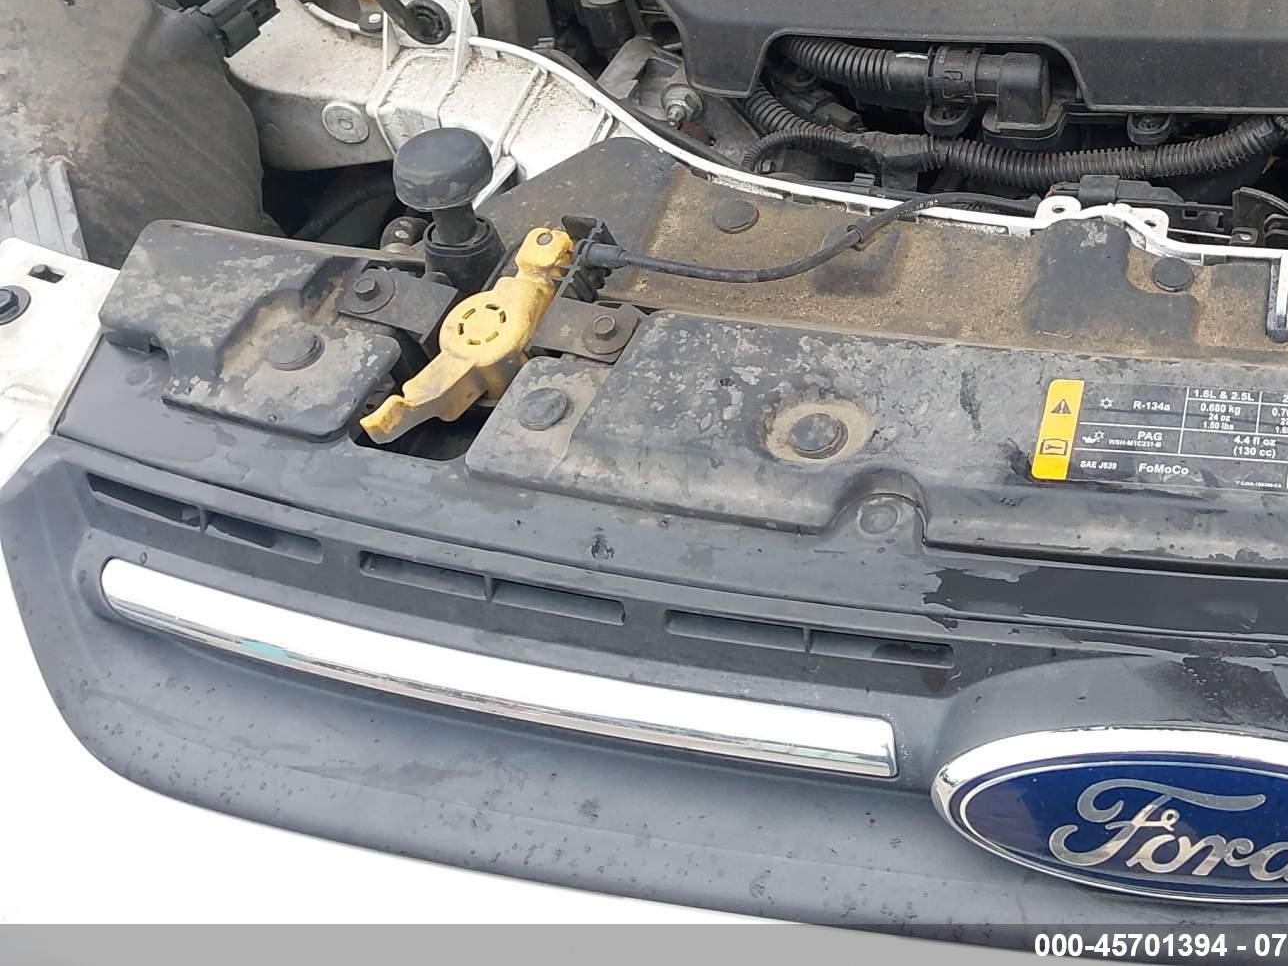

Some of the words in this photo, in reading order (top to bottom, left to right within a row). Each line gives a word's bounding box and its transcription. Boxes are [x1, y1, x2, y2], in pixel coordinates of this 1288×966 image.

[1219, 391, 1229, 400] &
[1132, 400, 1171, 411] R-134a
[1229, 404, 1241, 416] kg
[1208, 413, 1219, 421] 24
[1221, 414, 1231, 422] oz
[1221, 422, 1234, 431] lbs
[1137, 430, 1163, 441] PAG
[1233, 435, 1250, 445] 4.4
[1252, 436, 1261, 445] fl
[1262, 438, 1276, 446] oz
[1233, 446, 1256, 457] (130
[1258, 448, 1277, 459] cc)
[1079, 460, 1097, 469] SAE
[1138, 462, 1190, 475] FoMoCo
